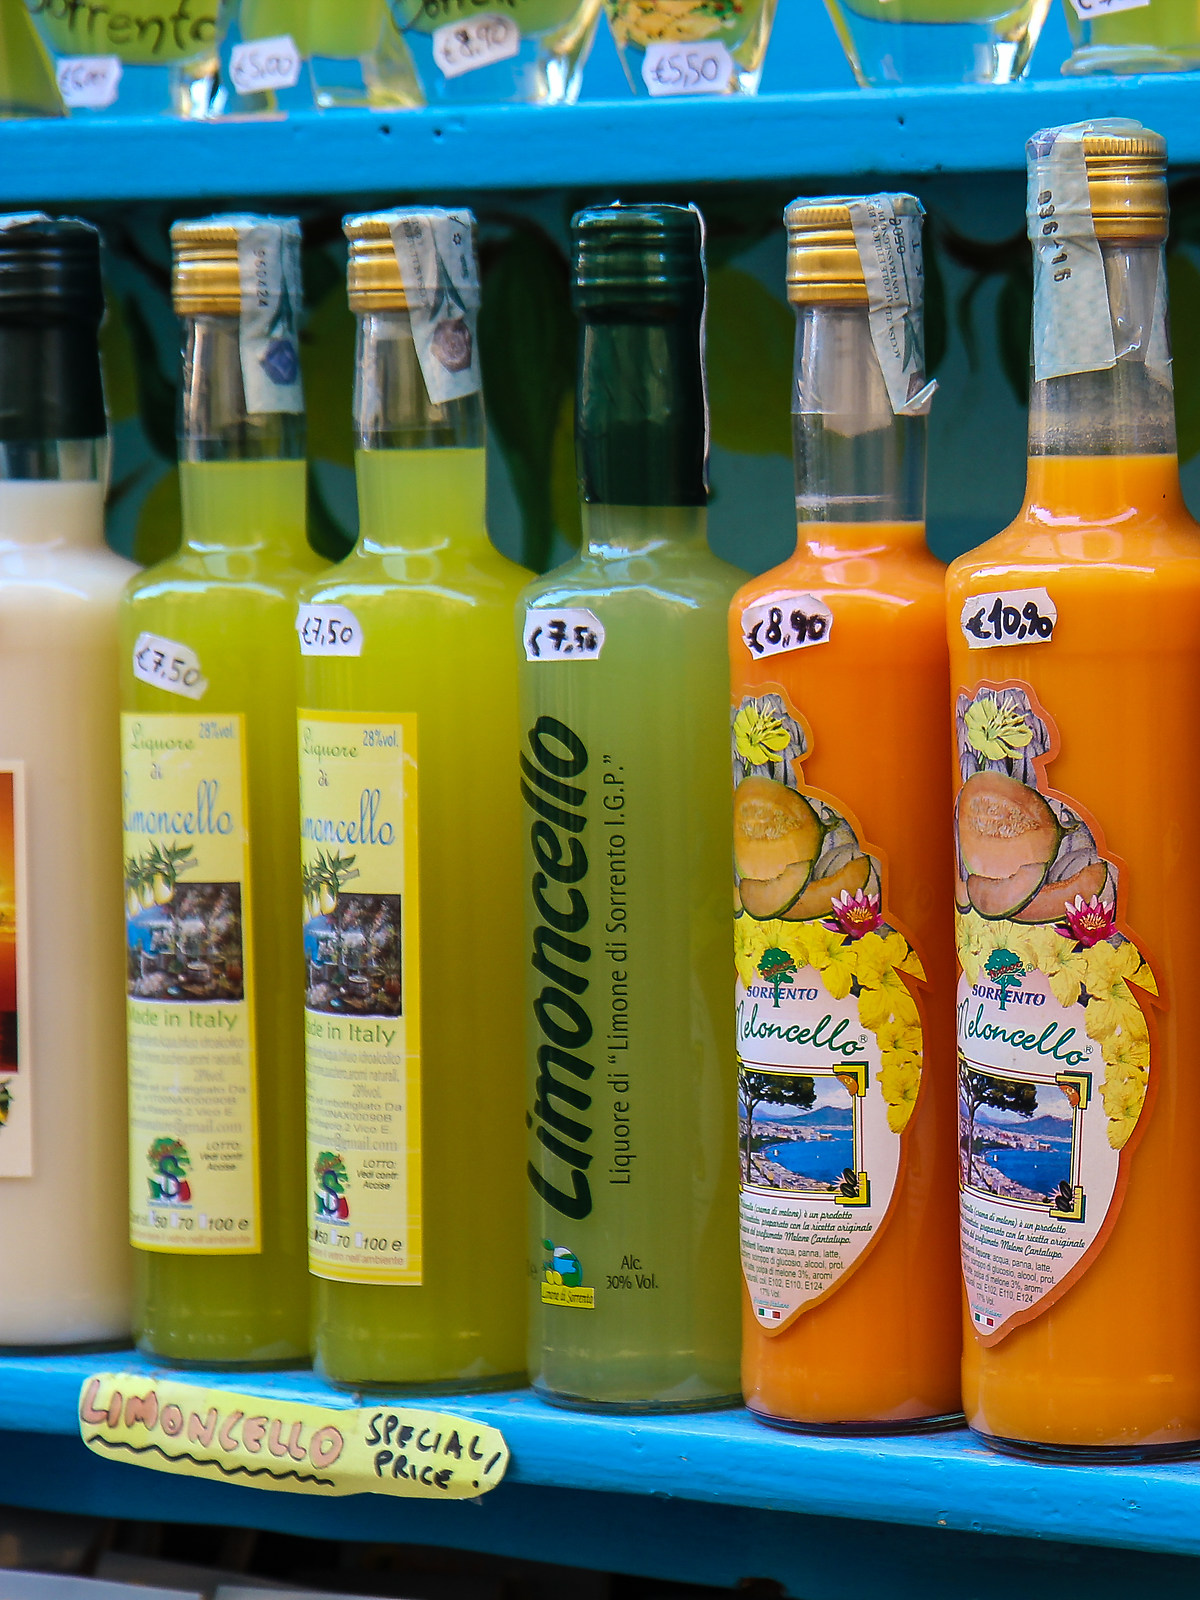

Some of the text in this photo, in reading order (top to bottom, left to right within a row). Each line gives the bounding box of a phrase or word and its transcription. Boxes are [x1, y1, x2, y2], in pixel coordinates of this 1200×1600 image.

[520, 715, 595, 1221] Limoncello
[604, 835, 637, 1185] Liquore di di Sorrento
[164, 1010, 238, 1032] in Italy
[327, 1022, 396, 1047] in Italy
[957, 997, 1089, 1066] Meloncello
[820, 1210, 852, 1221] prodotto
[208, 1219, 234, 1231] 100
[802, 1223, 873, 1234] la originale
[1035, 1223, 1067, 1234] prodotto
[364, 1237, 387, 1251] 100
[1017, 1231, 1085, 1249] la originale
[621, 1254, 642, 1270] Alc.
[606, 1273, 660, 1290] 30% Vol.
[813, 1271, 833, 1280] aromi
[1016, 1293, 1035, 1304] E124.
[79, 1378, 344, 1470] LIMONCELLO
